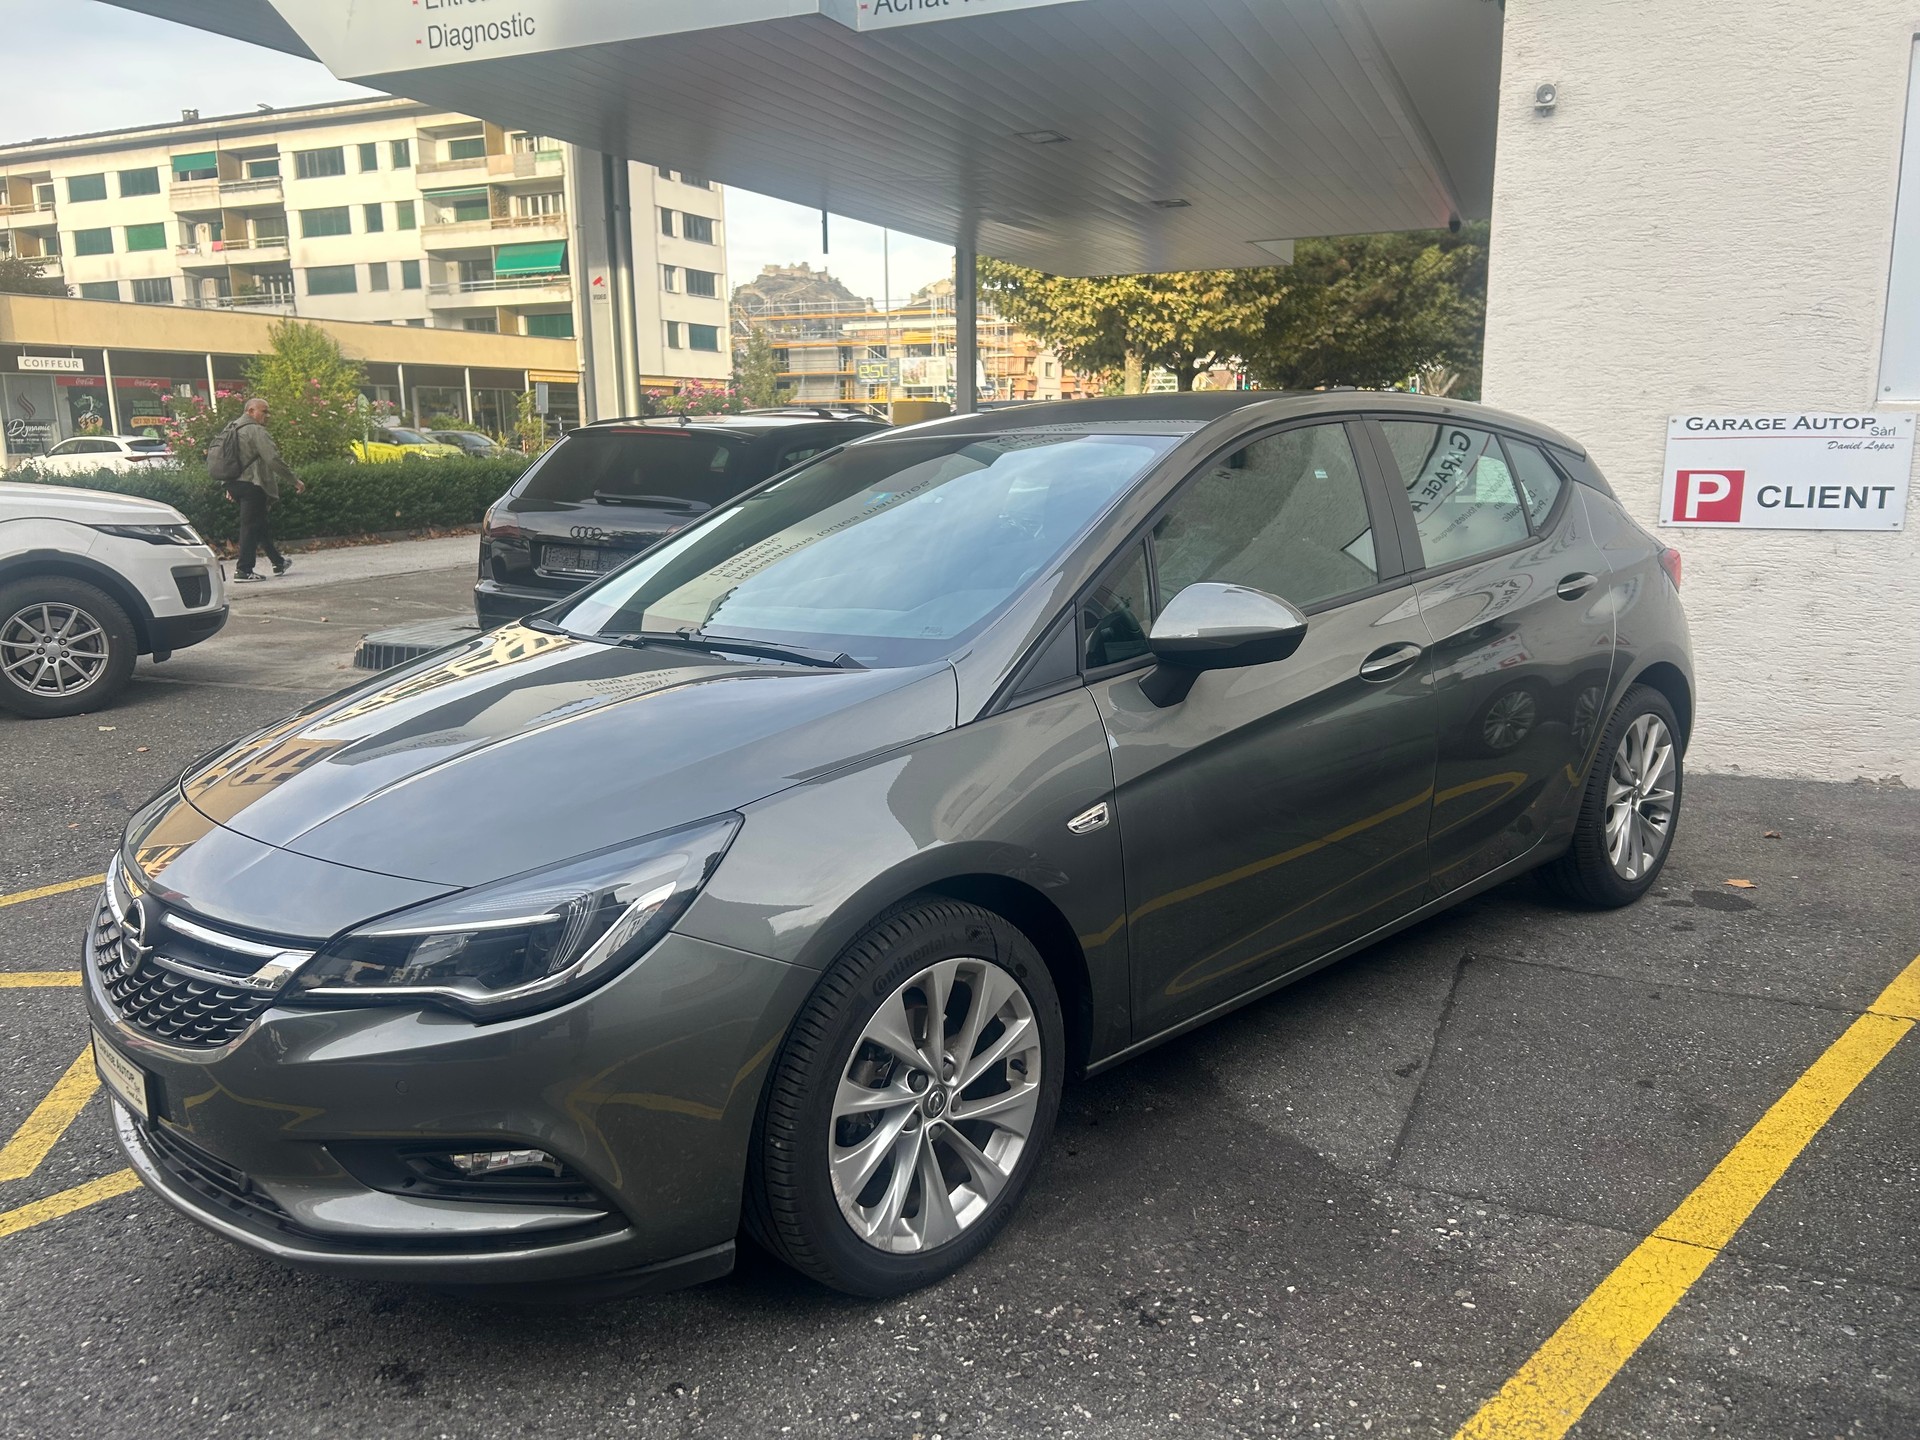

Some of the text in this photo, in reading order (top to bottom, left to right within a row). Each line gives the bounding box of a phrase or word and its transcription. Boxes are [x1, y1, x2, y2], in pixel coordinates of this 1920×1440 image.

[873, 0, 949, 15] Aca
[427, 12, 536, 51] Diagnostic
[23, 358, 79, 369] COIFFEUR
[1685, 416, 1787, 431] GARAGE
[1792, 415, 1877, 430] AUTOP
[1827, 440, 1895, 451] Daniel Lopes
[1684, 473, 1895, 519] P CLIENT
